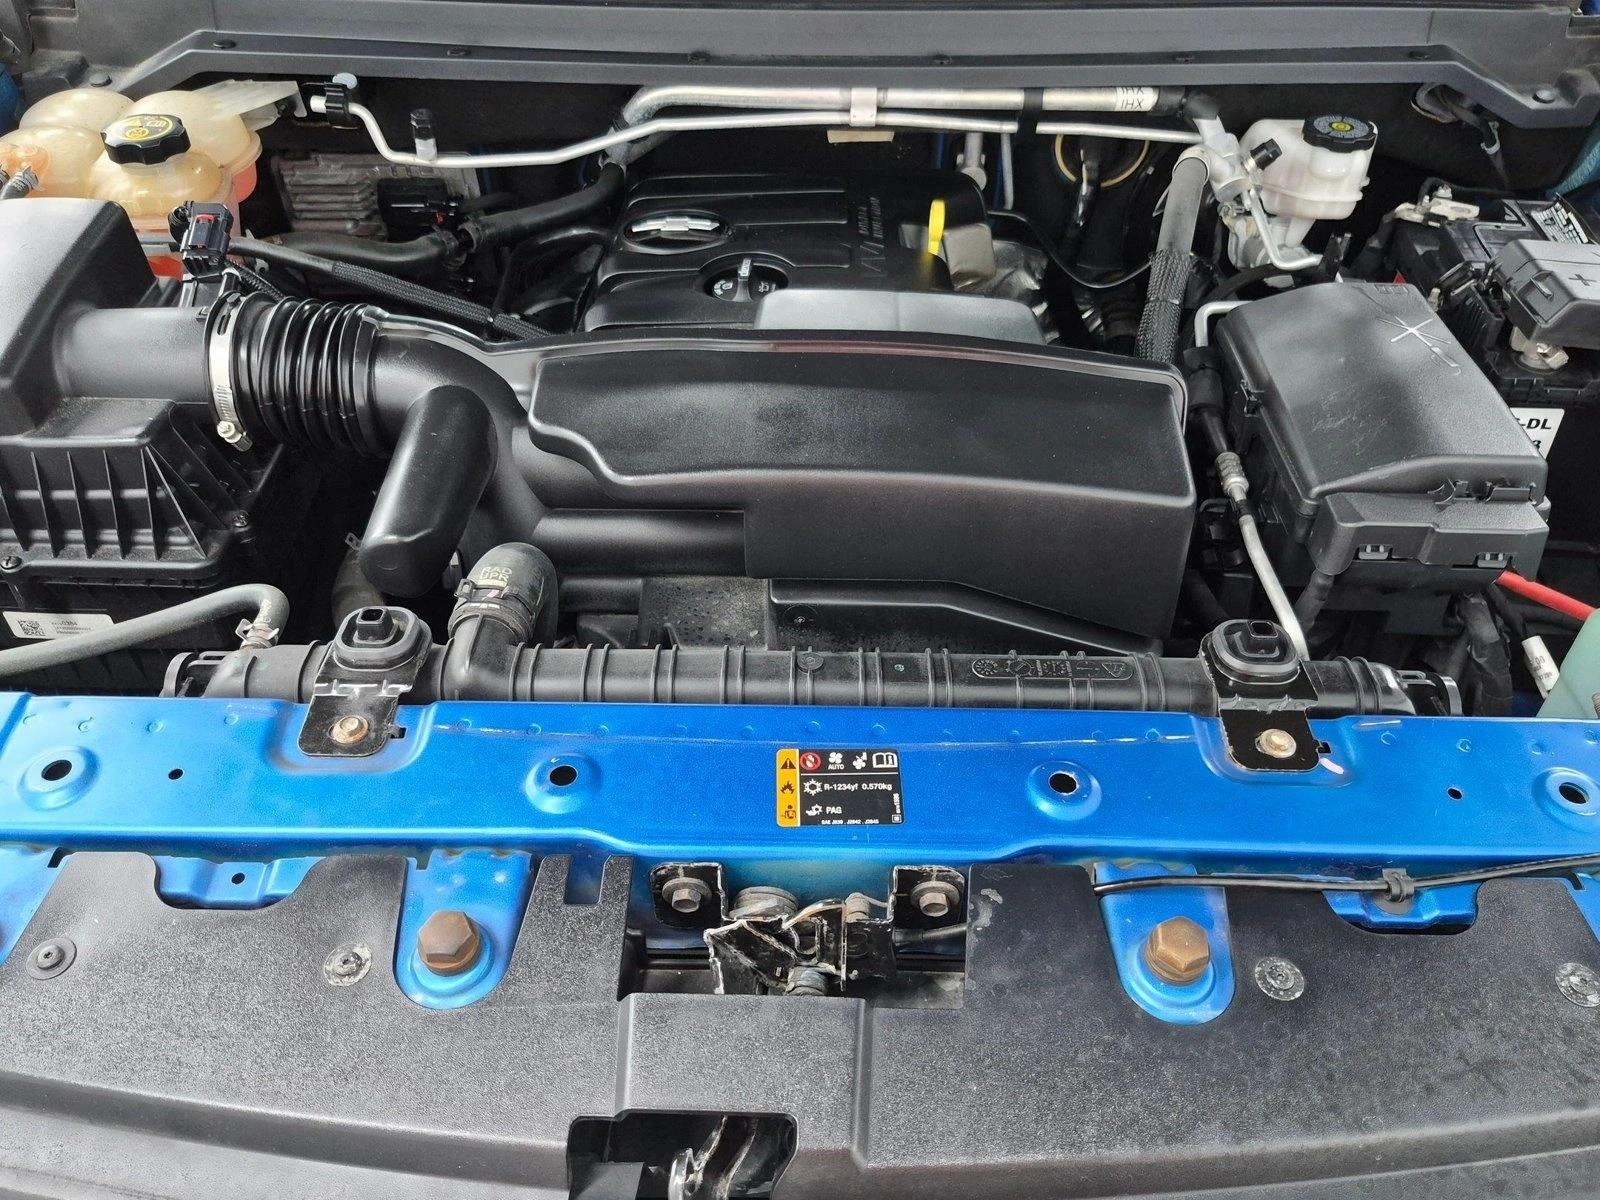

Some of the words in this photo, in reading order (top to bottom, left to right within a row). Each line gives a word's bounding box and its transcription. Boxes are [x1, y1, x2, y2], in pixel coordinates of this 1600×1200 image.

[1121, 98, 1144, 110] IHX
[824, 783, 859, 791] R-1234yf
[825, 806, 843, 814] PAG
